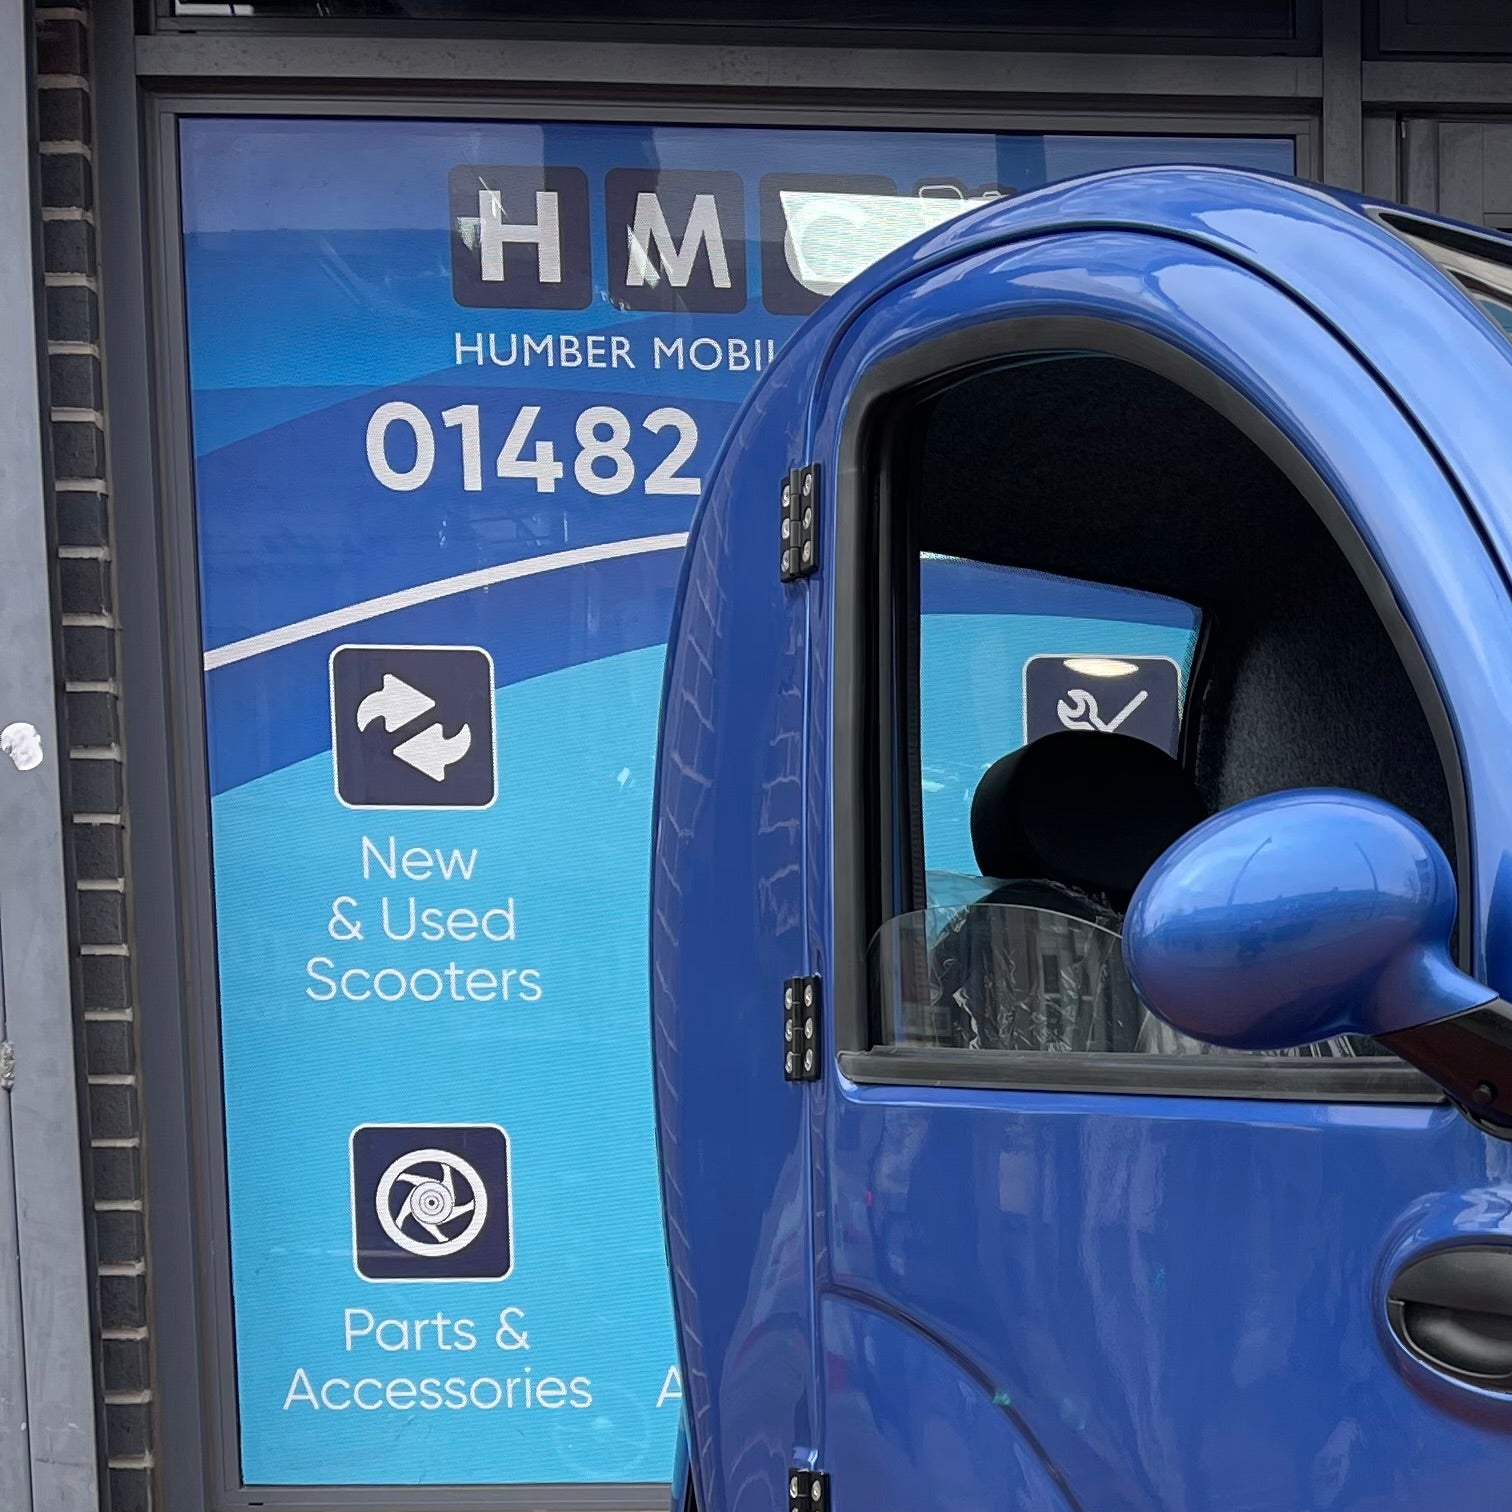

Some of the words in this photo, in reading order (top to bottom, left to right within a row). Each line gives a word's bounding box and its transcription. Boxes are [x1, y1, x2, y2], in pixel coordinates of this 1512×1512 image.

[454, 333, 636, 370] HUMBER
[365, 400, 702, 496] 01482
[361, 835, 478, 880] New
[327, 896, 363, 941] &
[382, 897, 516, 942] Used
[305, 957, 543, 1002] Scooters
[343, 1307, 477, 1352] Parts
[494, 1307, 531, 1351] &
[282, 1366, 593, 1411] Accessories
